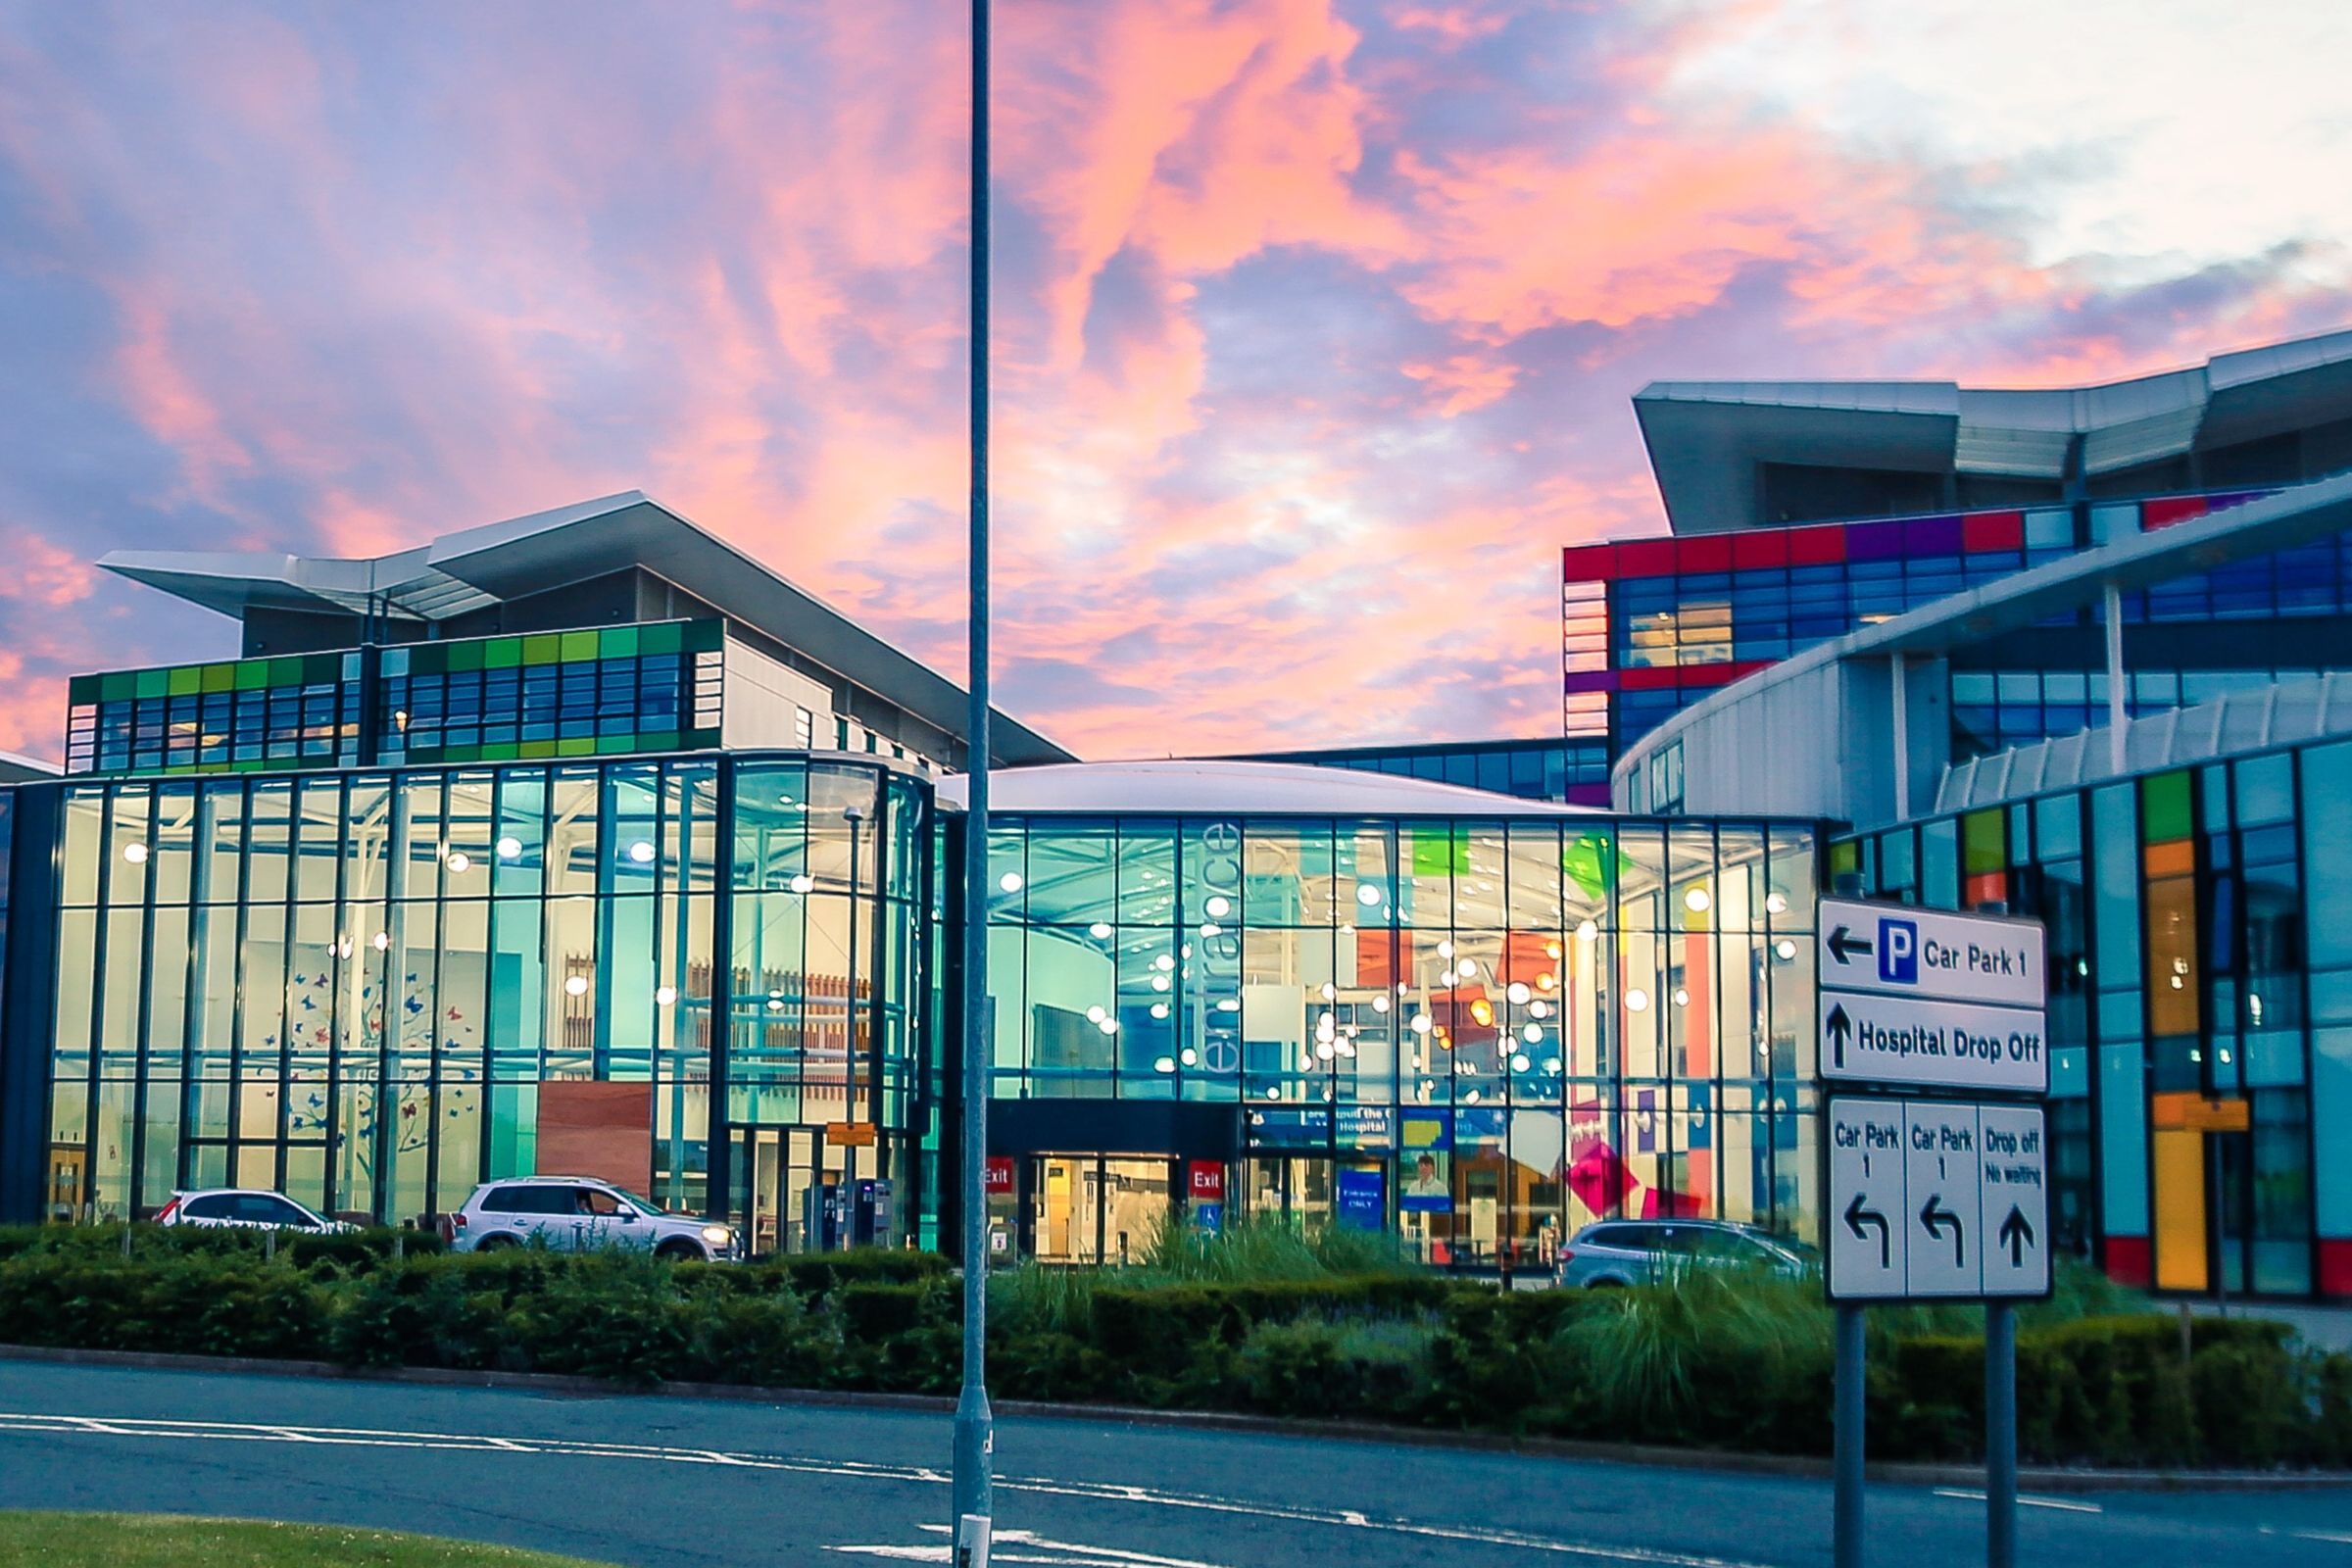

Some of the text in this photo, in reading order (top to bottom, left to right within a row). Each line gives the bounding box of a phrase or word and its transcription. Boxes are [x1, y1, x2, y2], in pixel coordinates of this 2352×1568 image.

[1924, 939, 1959, 970] Car
[1968, 943, 2013, 975] Park
[2019, 950, 2027, 976] 1
[1858, 1019, 2040, 1065] Hospital Drop Off
[1340, 1121, 1386, 1134] Hospital
[1835, 1120, 1899, 1150] Car Park
[1912, 1123, 1973, 1152] Car Park
[1985, 1127, 2039, 1157] Drop off
[1195, 1171, 1218, 1188] Exit
[1863, 1153, 1870, 1178] 1
[1938, 1156, 1945, 1180] 1
[1985, 1161, 2041, 1190] No waiting
